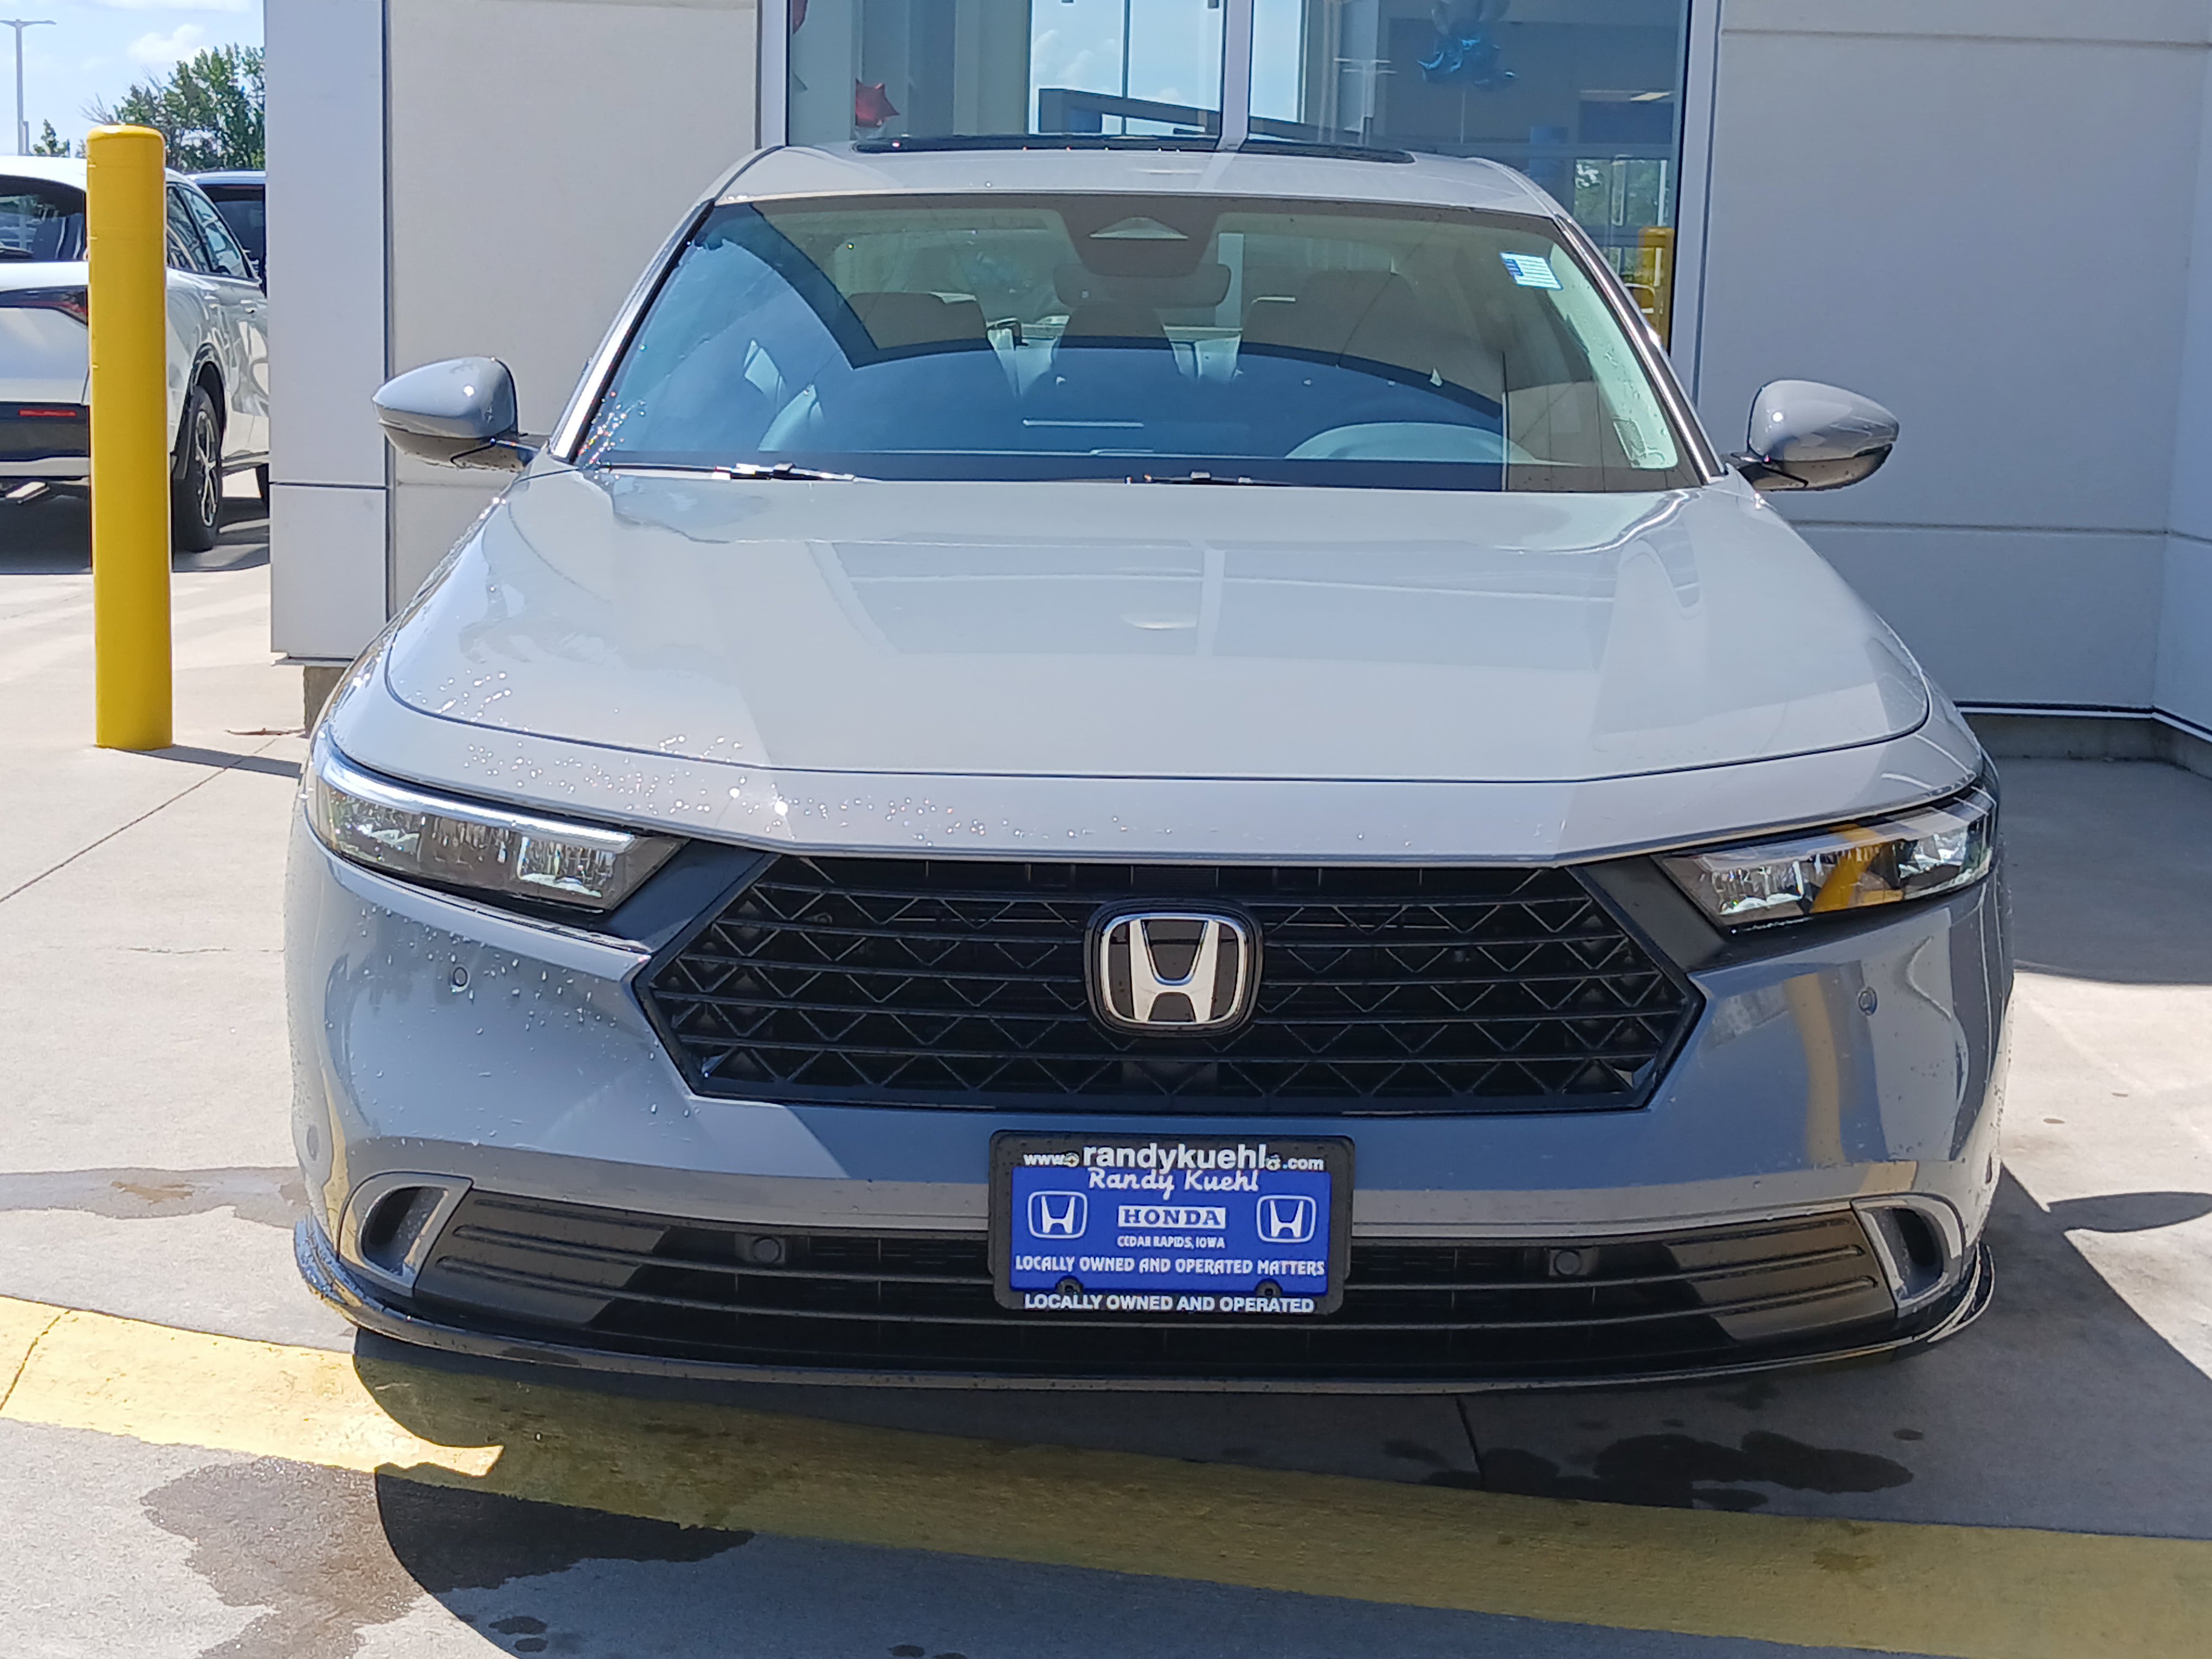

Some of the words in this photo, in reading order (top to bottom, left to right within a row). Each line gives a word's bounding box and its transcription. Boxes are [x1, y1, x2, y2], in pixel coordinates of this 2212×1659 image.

[1083, 1142, 1266, 1174] randykuehl
[1087, 1167, 1174, 1201] Randy
[1184, 1169, 1259, 1191] Kuehl
[1123, 1208, 1221, 1225] HONDA
[1195, 1236, 1225, 1249] IOWA
[1015, 1255, 1075, 1272] LOCALLY
[1079, 1256, 1135, 1272] OWNED
[1139, 1257, 1171, 1274] AND
[1175, 1258, 1253, 1275] OPERATED
[1257, 1259, 1325, 1276] MATTERS
[1024, 1293, 1103, 1309] LOCALLY
[1106, 1295, 1174, 1310] OWNED
[1176, 1296, 1216, 1311] AND
[1219, 1296, 1315, 1314] OPERATED
